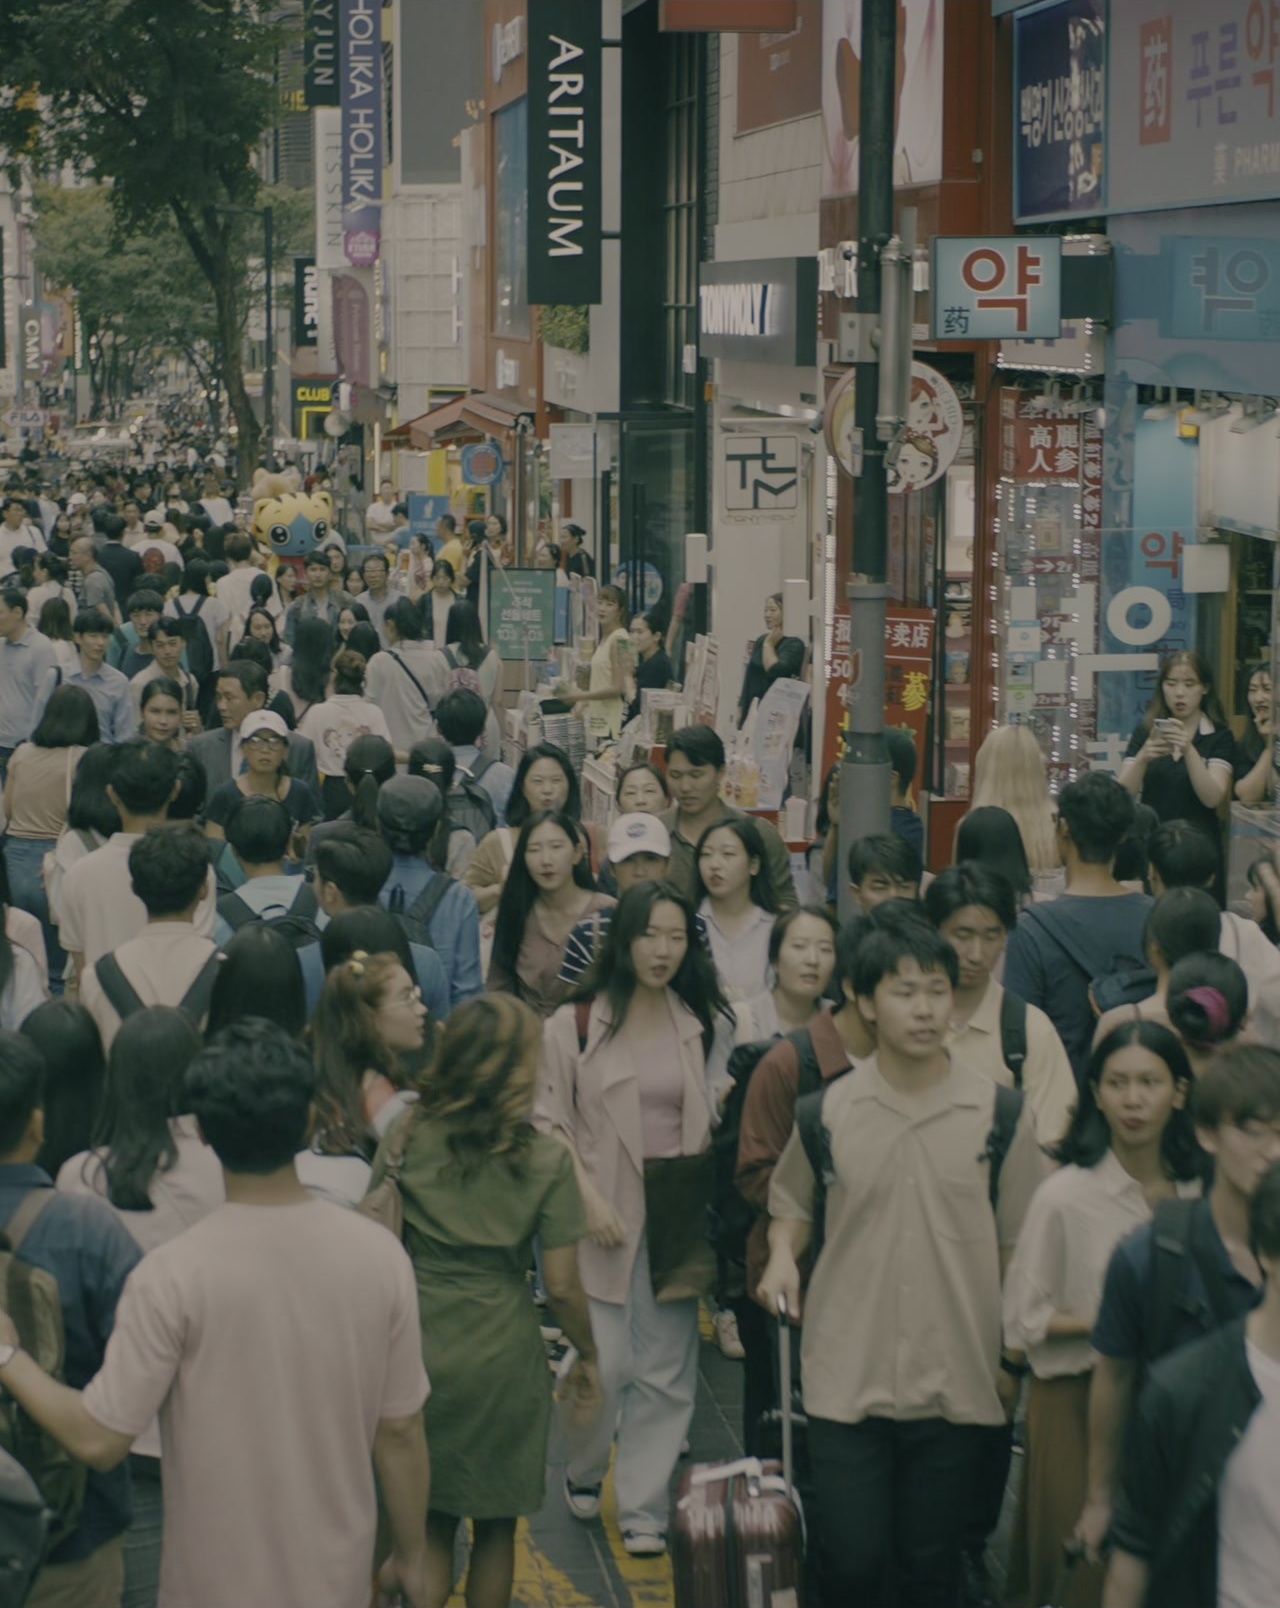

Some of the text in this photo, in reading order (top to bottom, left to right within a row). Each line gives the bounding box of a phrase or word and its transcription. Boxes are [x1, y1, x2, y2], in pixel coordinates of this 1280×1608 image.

[349, 0, 374, 212] HOLIKA HOLIKA
[548, 34, 584, 257] ARITAUM
[944, 307, 970, 334] 药
[962, 245, 1041, 332] 약
[10, 411, 40, 422] FILA
